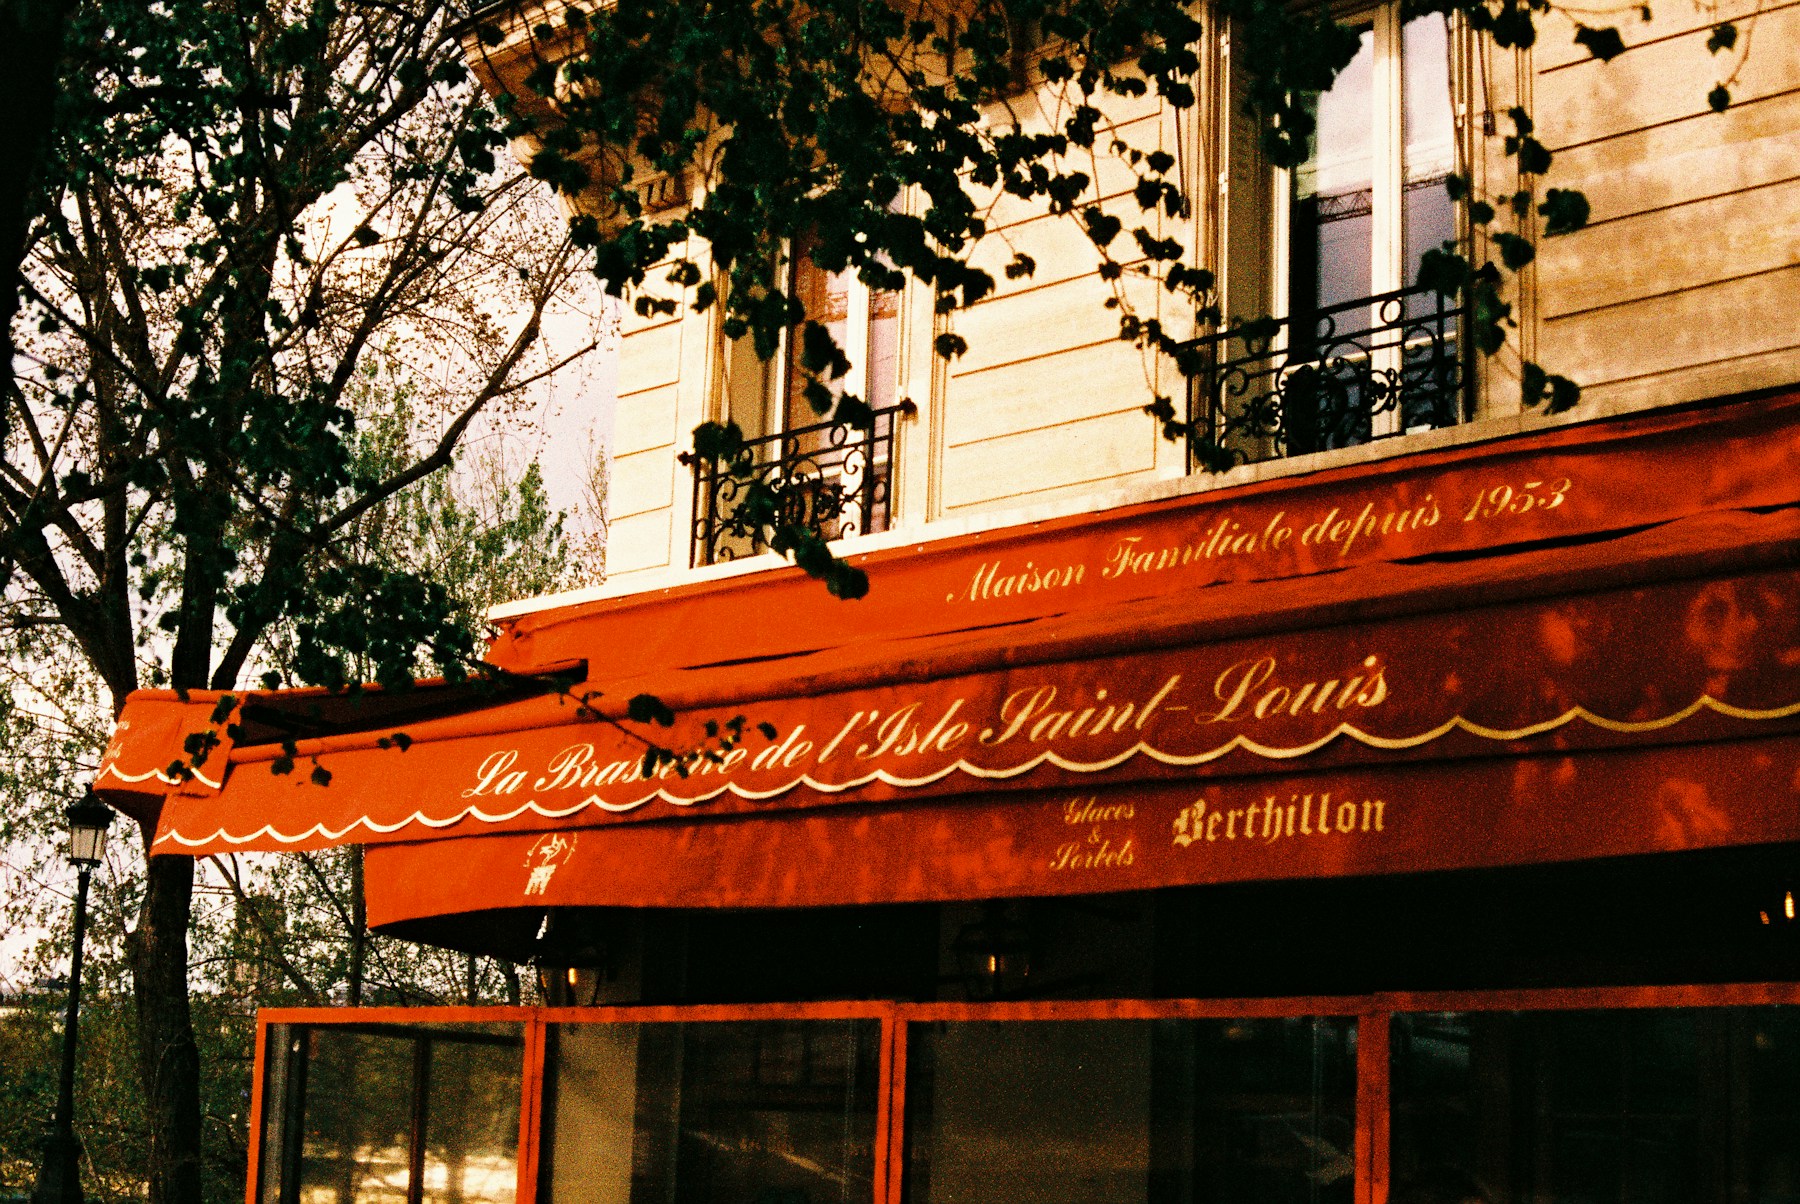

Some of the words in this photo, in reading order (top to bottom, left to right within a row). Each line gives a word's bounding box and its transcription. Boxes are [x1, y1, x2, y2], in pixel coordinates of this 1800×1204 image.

[946, 561, 1085, 604] Maison
[1102, 512, 1293, 579] Familiale
[1301, 493, 1440, 557] depuis
[1463, 477, 1573, 523] 1953
[461, 750, 527, 798] La
[751, 725, 814, 773] de
[1063, 796, 1135, 825] Glaces
[1087, 825, 1101, 845] &
[1172, 794, 1386, 848] Berthillon
